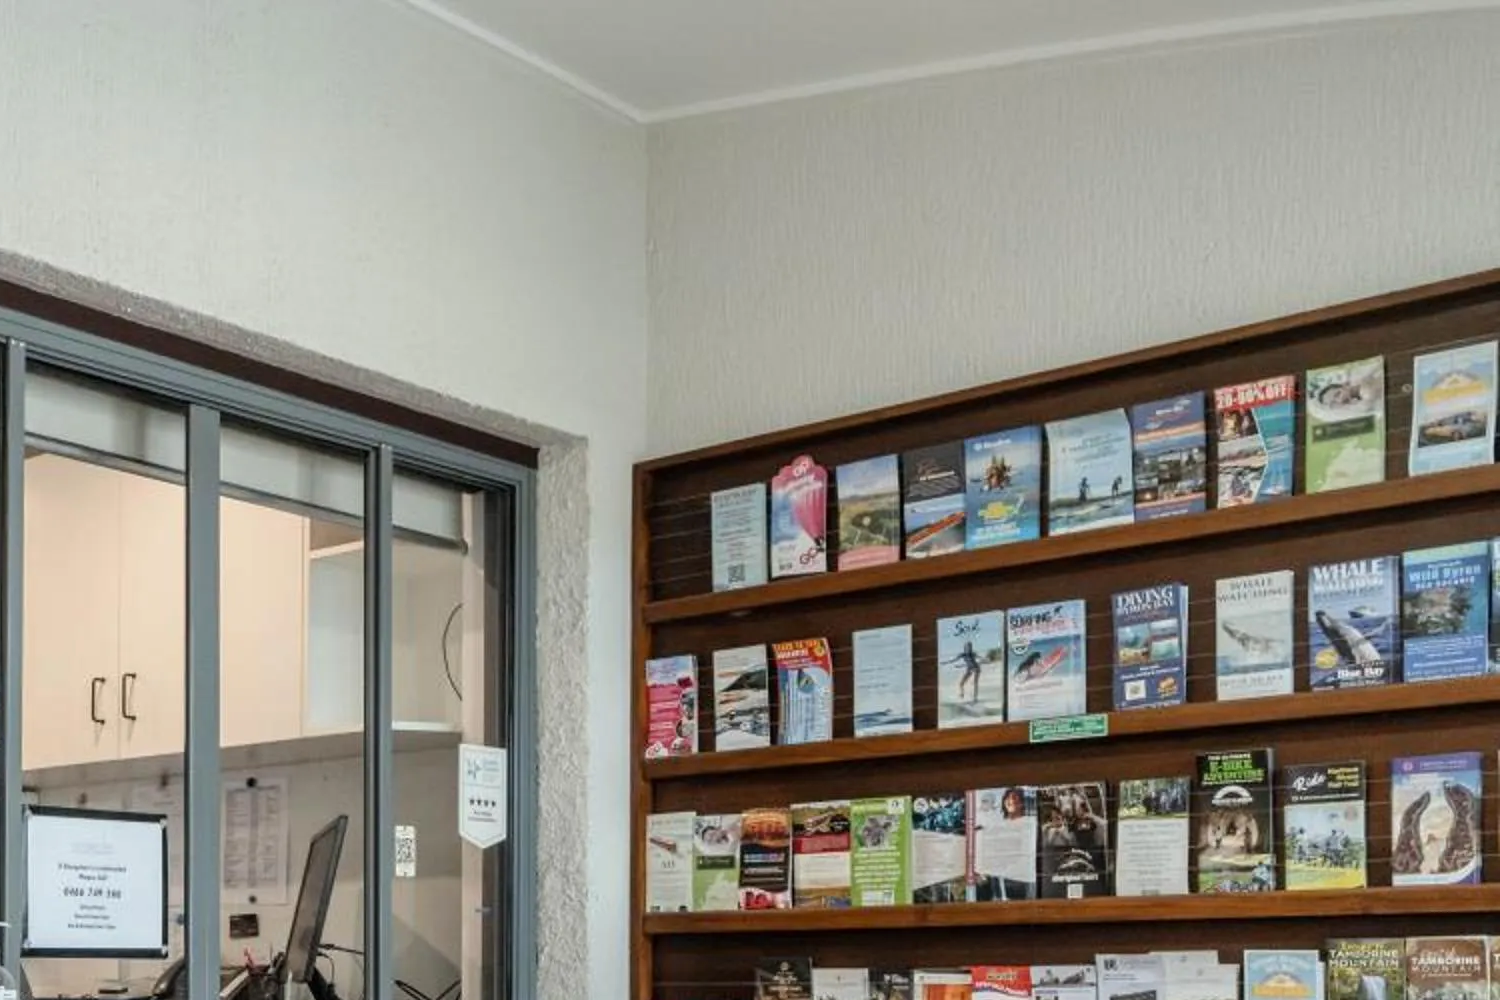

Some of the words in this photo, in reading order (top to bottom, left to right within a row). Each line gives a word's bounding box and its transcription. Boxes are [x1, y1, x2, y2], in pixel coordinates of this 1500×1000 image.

[1312, 557, 1384, 581] WHALE
[1116, 583, 1174, 610] DIVING
[1411, 953, 1481, 965] TAMBORINE
